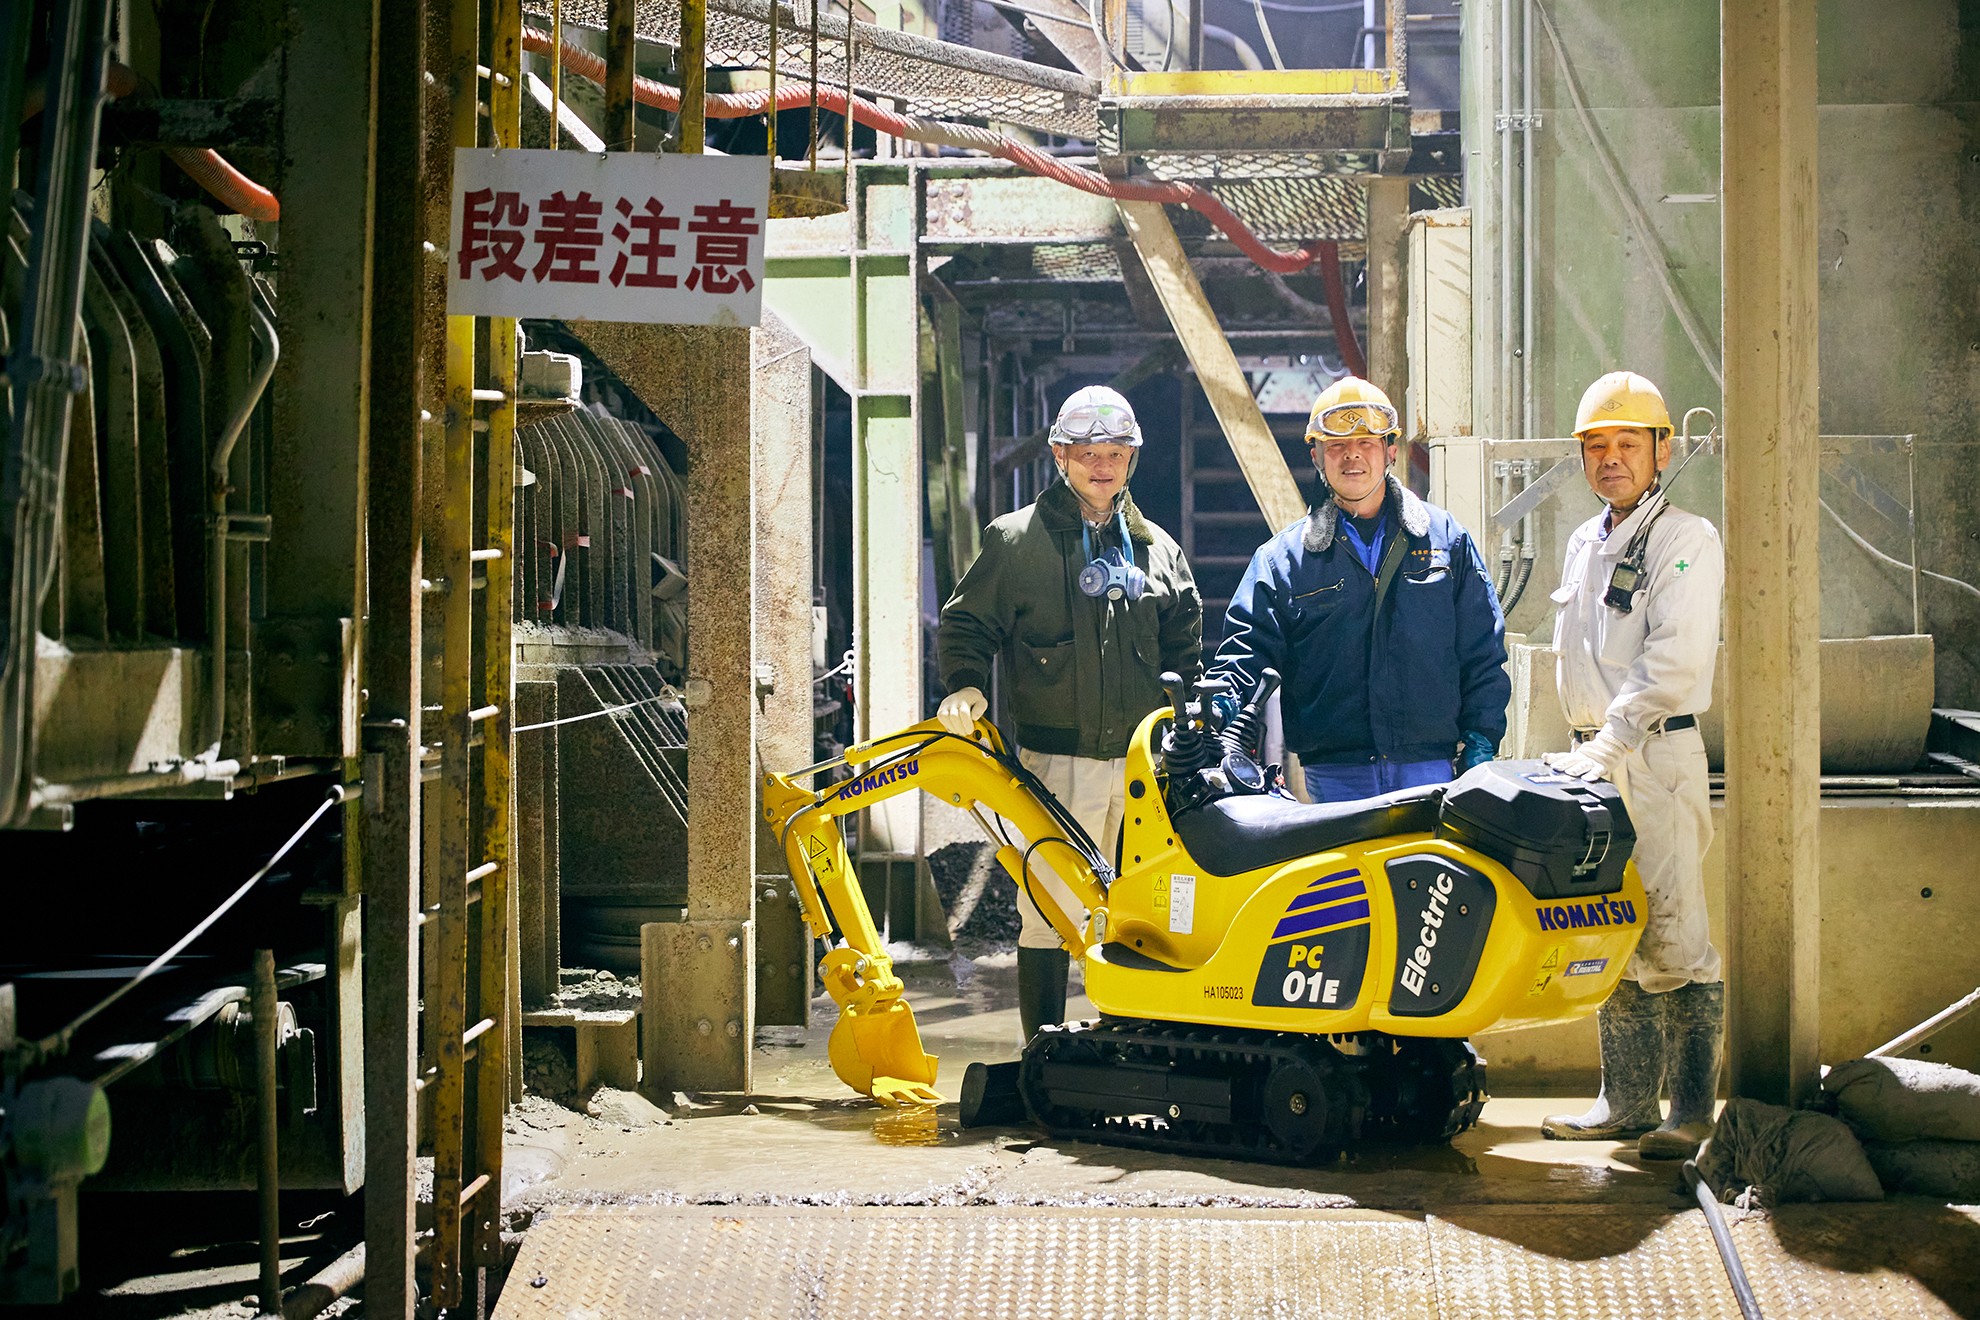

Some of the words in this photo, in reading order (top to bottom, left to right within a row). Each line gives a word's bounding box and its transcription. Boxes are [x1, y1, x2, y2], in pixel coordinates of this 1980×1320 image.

[458, 187, 760, 294] 段差注意
[1536, 895, 1637, 931] KOMATSU
[1400, 872, 1454, 997] Electric
[1288, 945, 1325, 969] PC
[1204, 986, 1244, 1000] HA105023
[1282, 970, 1340, 1004] 01E
